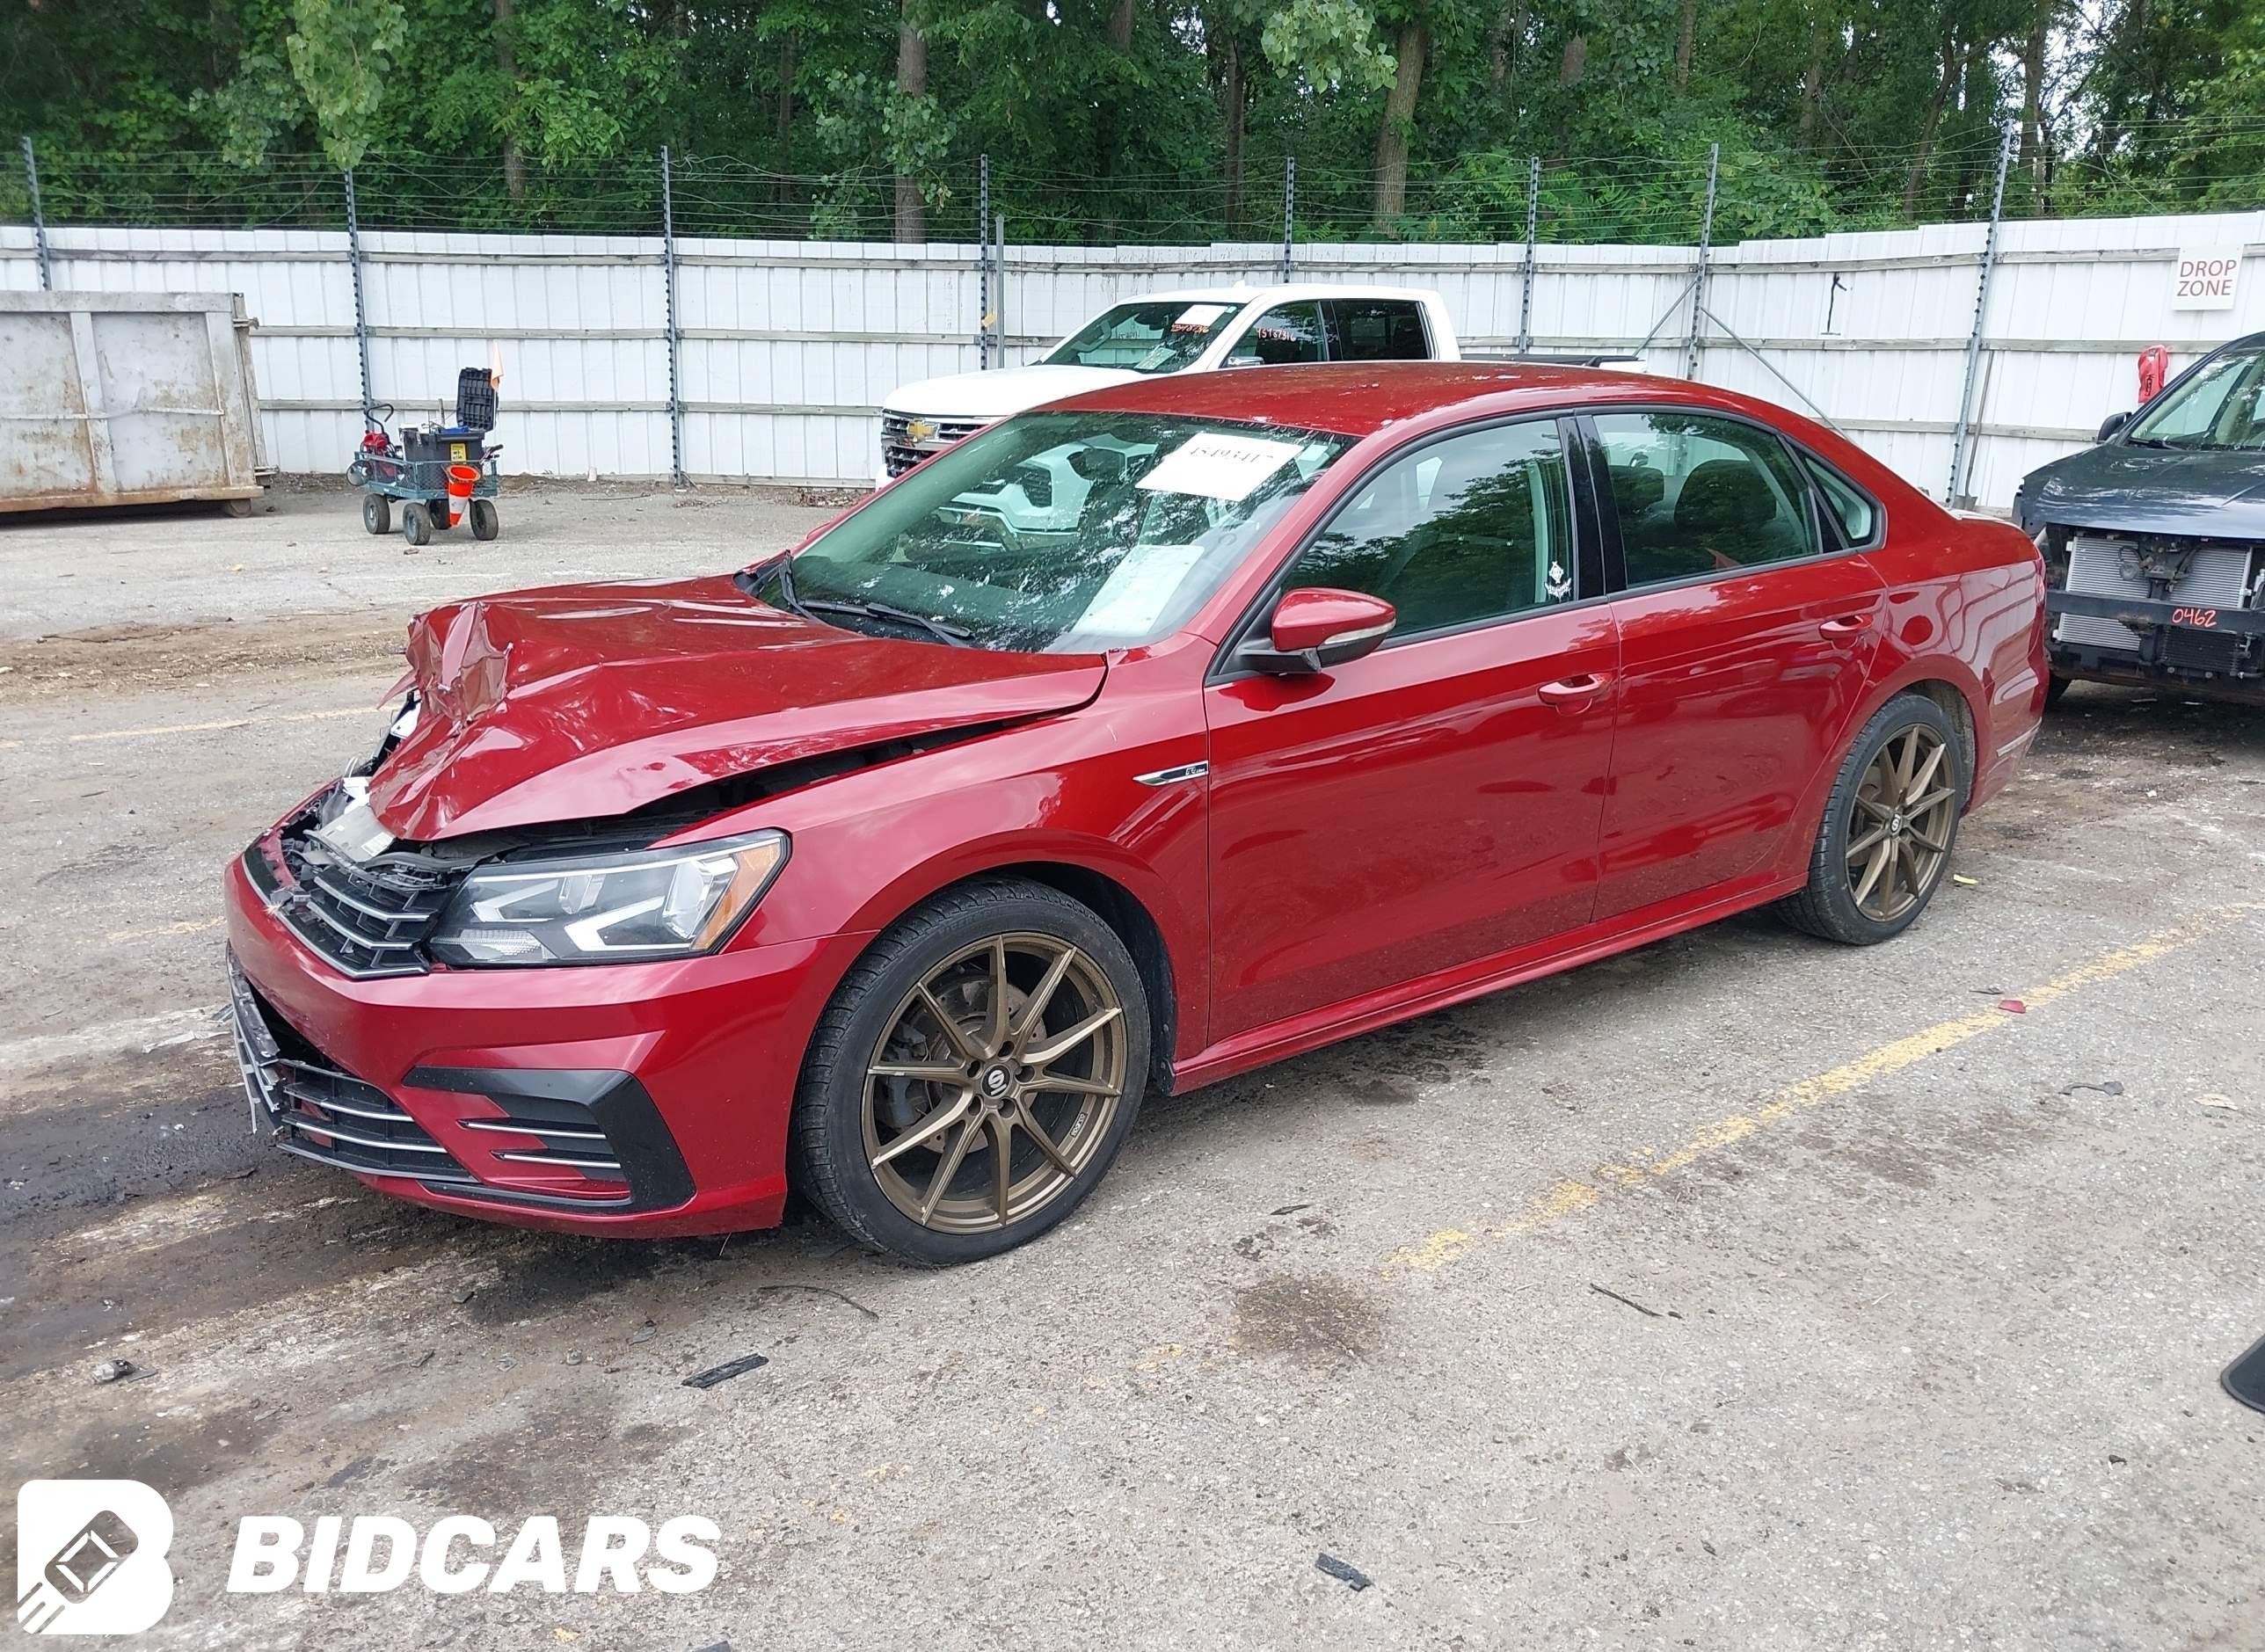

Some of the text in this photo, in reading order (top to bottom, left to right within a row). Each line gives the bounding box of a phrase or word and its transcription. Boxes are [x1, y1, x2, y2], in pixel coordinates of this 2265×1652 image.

[2180, 259, 2237, 278] DROP
[2176, 279, 2232, 296] ZONE
[2172, 608, 2217, 627] 0462
